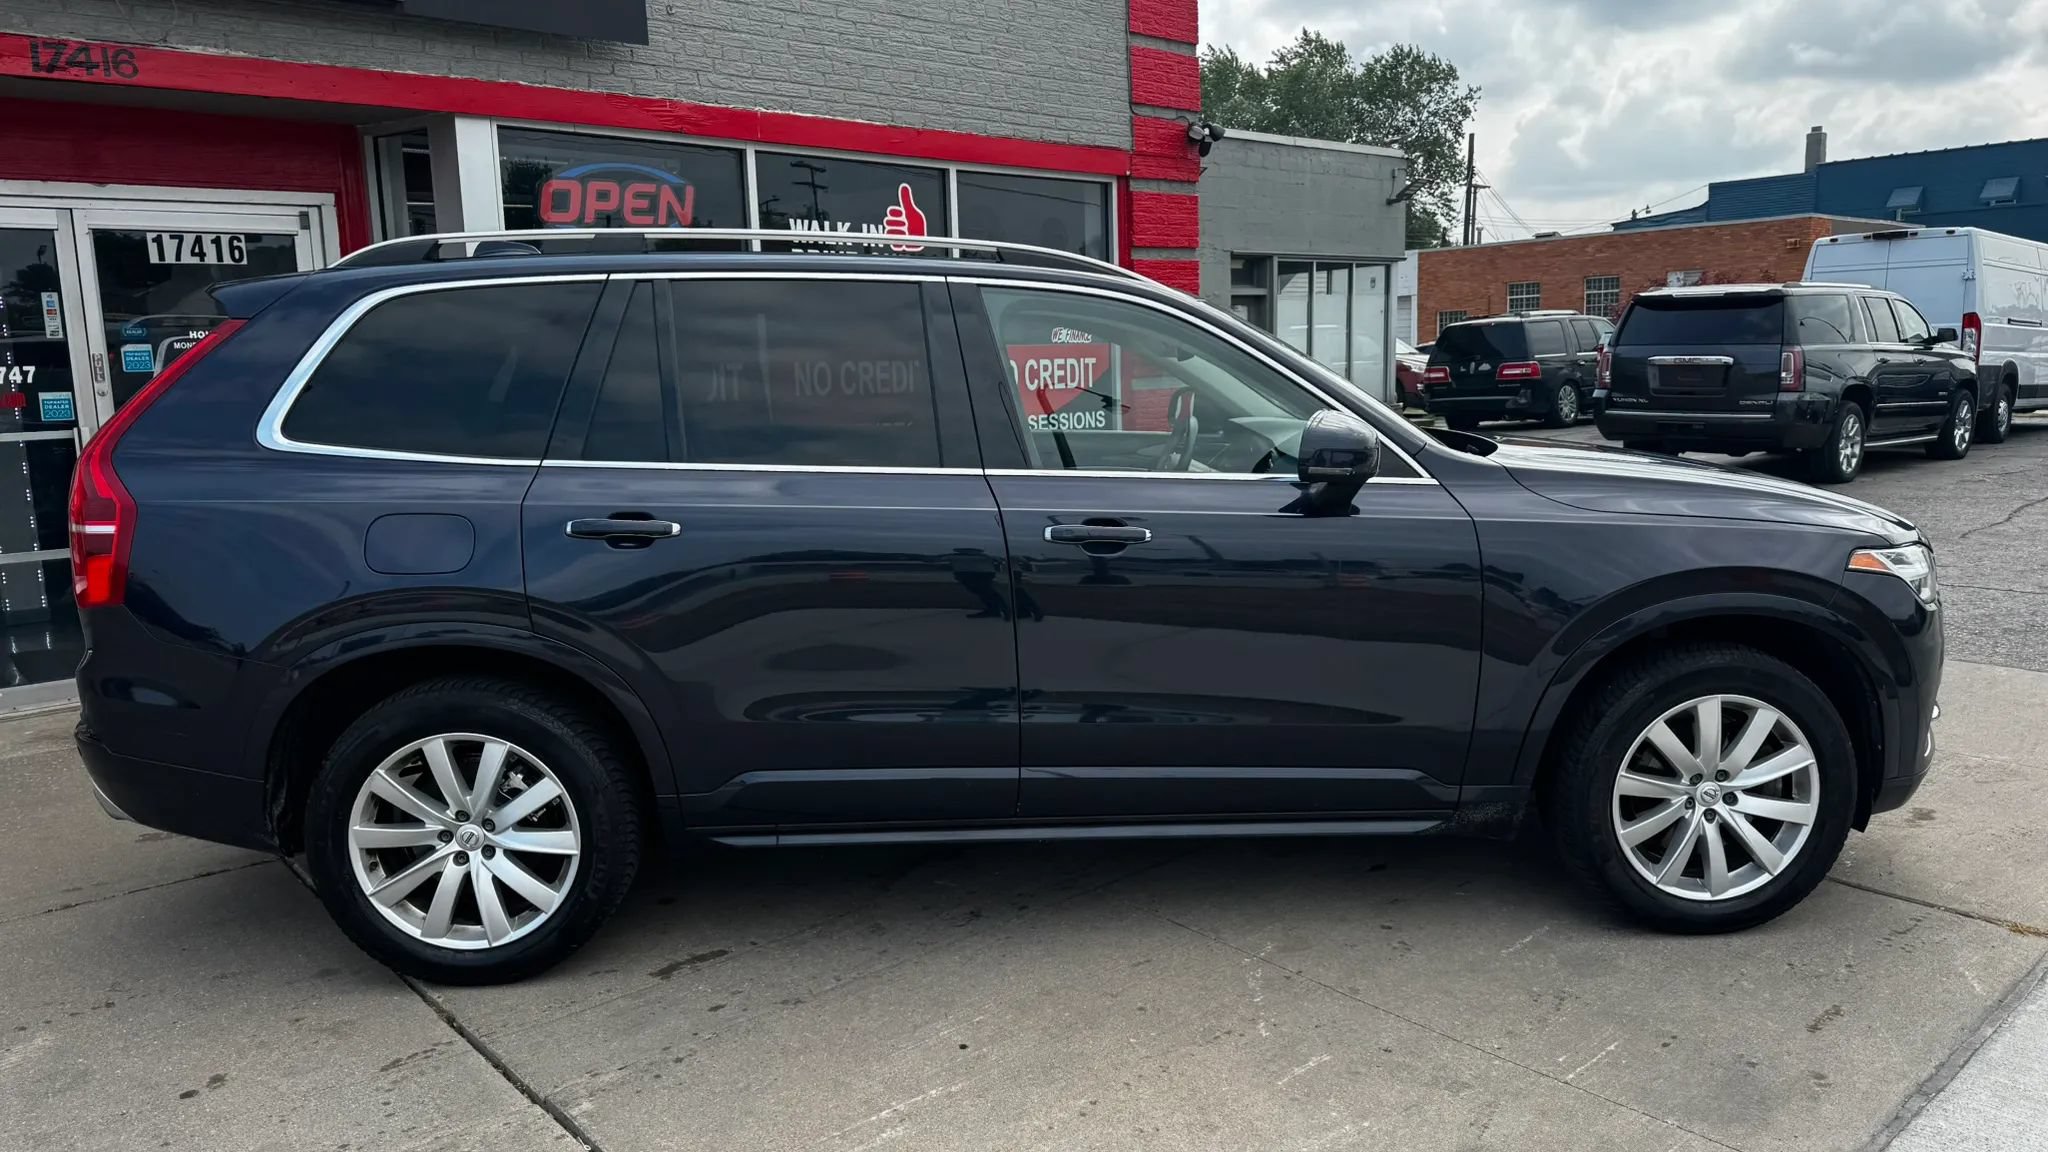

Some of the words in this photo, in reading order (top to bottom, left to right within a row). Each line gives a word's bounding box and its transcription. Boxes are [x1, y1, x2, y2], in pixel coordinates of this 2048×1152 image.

[30, 40, 139, 79] 17416
[540, 179, 694, 226] OPEN
[151, 234, 245, 264] 17416
[1052, 327, 1064, 343] WE
[794, 361, 831, 397] NO
[840, 360, 920, 396] CREDI
[1025, 357, 1097, 391] CREDIT
